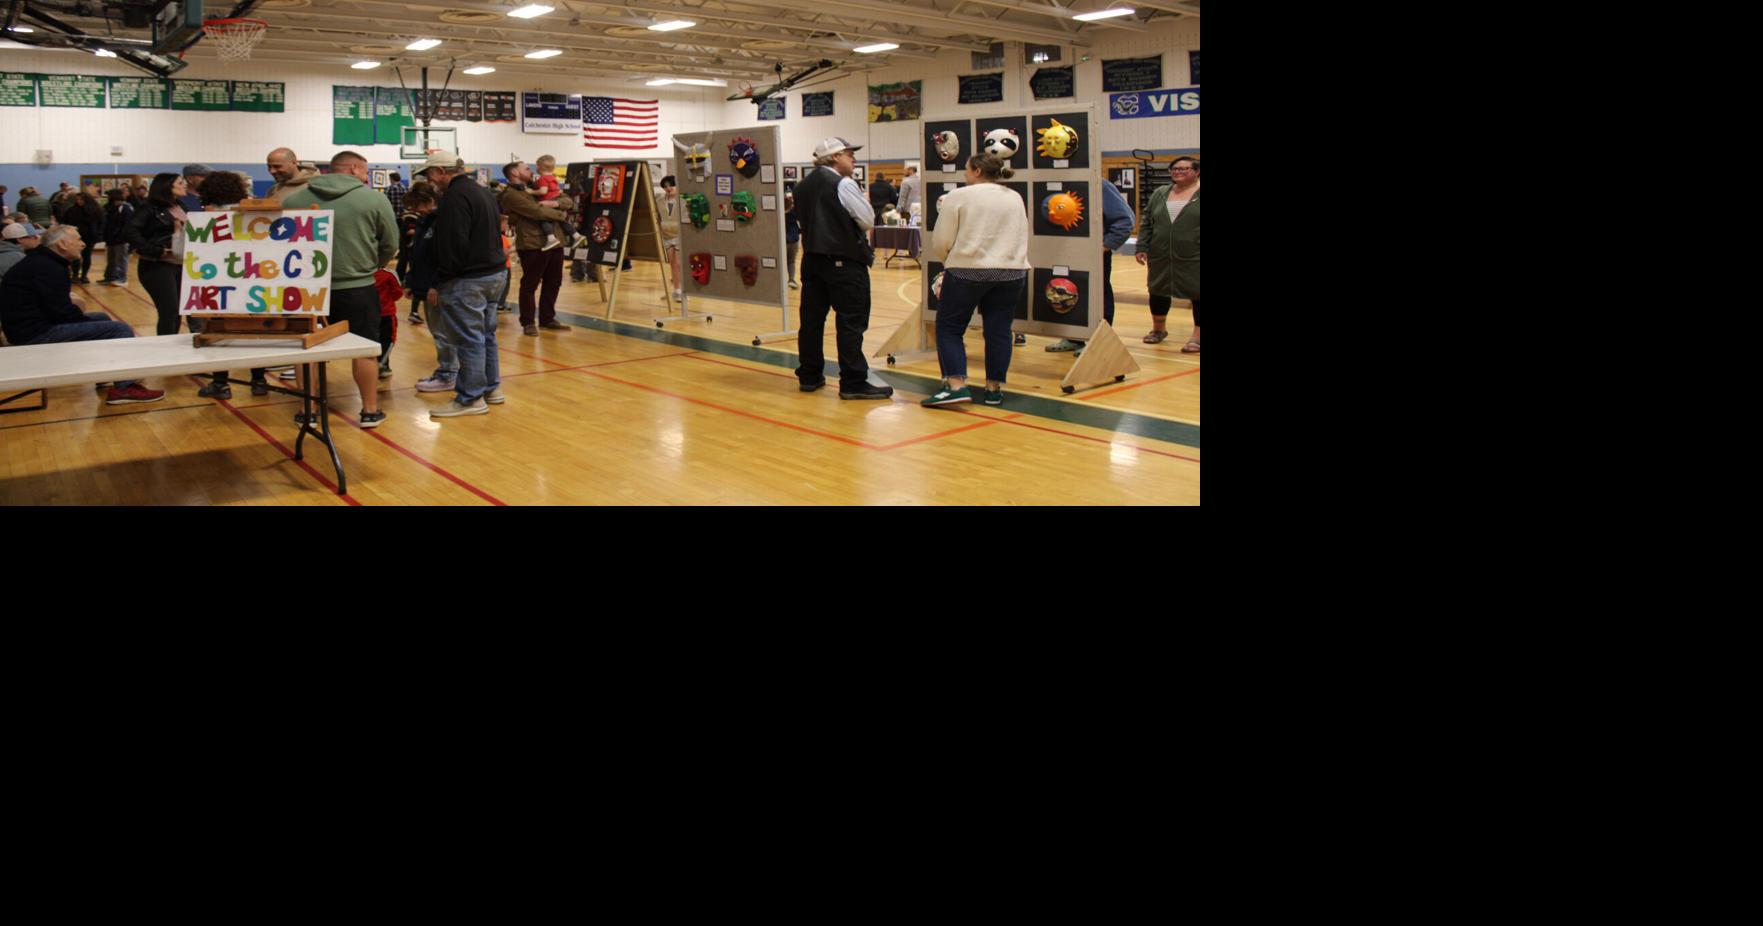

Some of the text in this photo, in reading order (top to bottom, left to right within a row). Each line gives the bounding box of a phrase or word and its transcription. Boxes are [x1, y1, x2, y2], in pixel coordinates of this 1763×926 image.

[1148, 91, 1200, 112] VIS
[185, 213, 329, 243] WELCOME
[184, 251, 218, 280] to
[224, 251, 280, 279] the
[184, 285, 328, 313] ART SHOW
